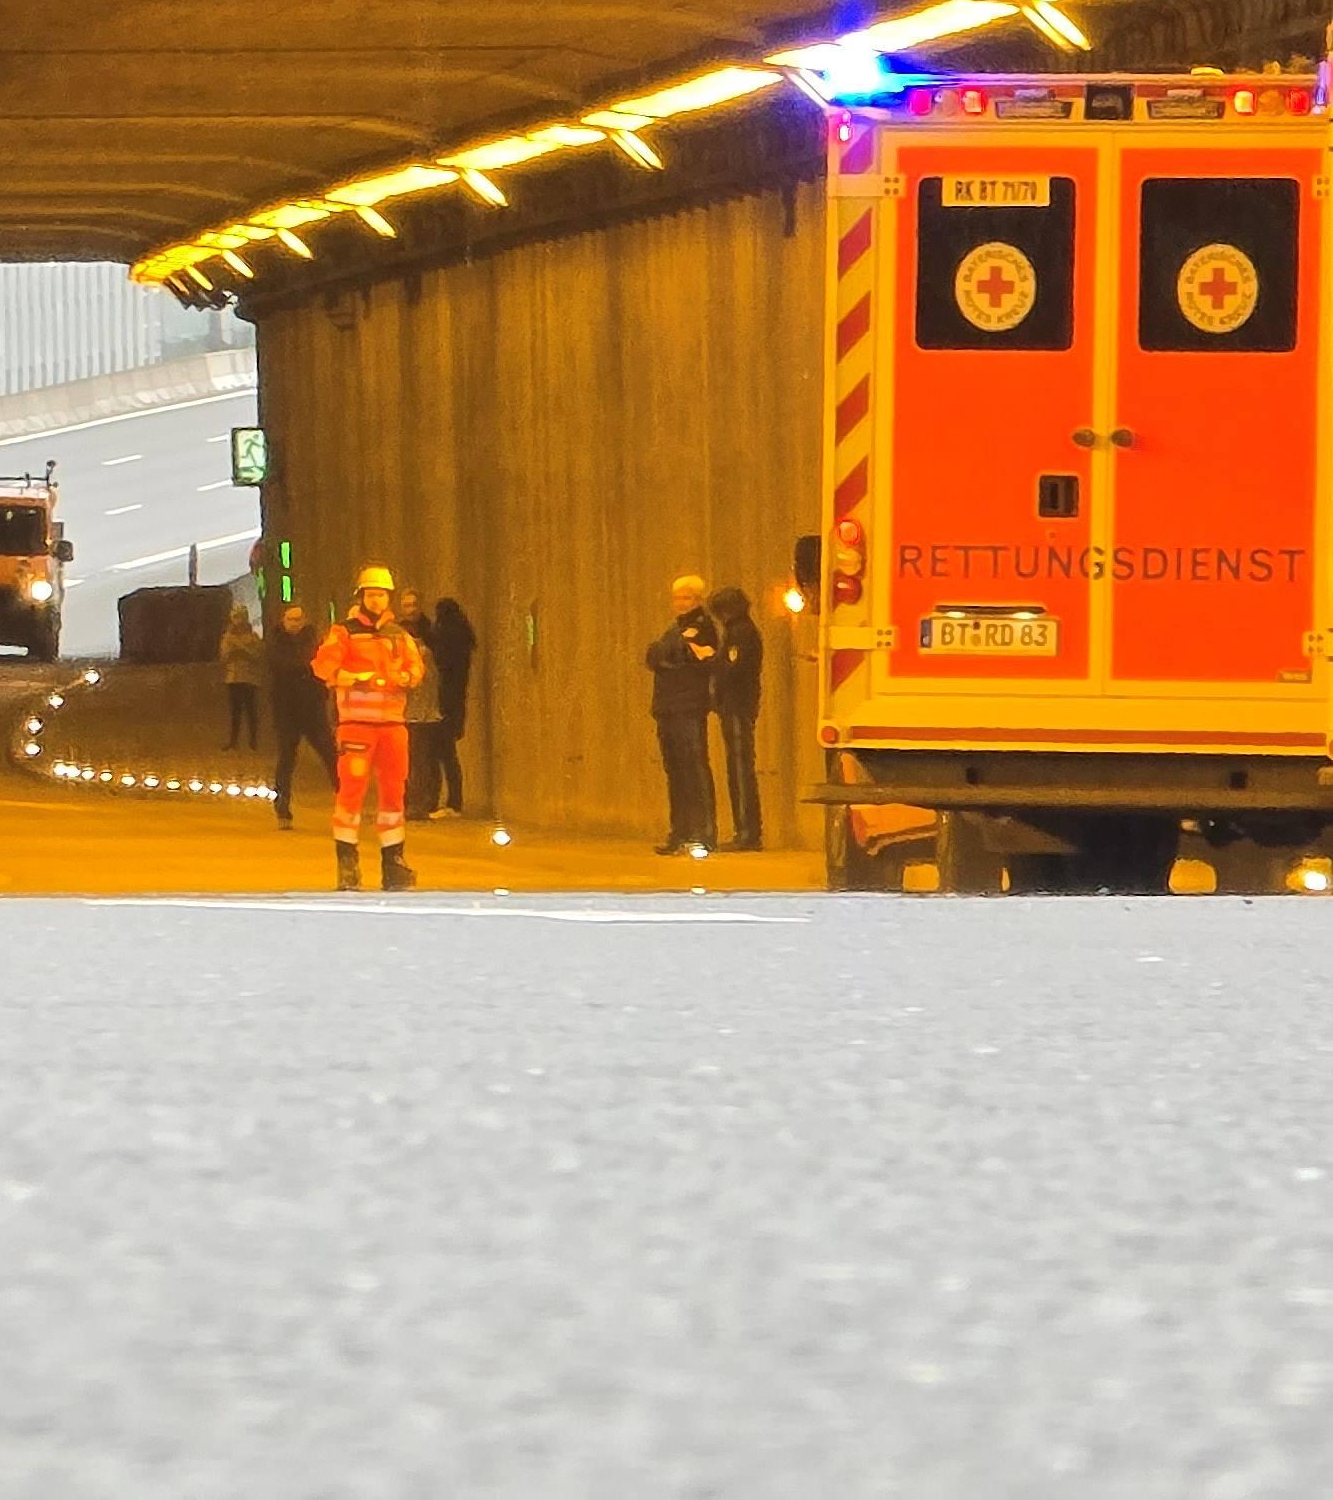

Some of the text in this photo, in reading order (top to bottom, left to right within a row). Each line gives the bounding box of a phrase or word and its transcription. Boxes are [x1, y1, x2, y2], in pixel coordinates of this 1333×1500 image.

[955, 180, 975, 201] RK
[979, 180, 997, 201] BT
[899, 544, 1306, 583] RETTUNGSDIENST
[941, 623, 1048, 647] BT RD 83
